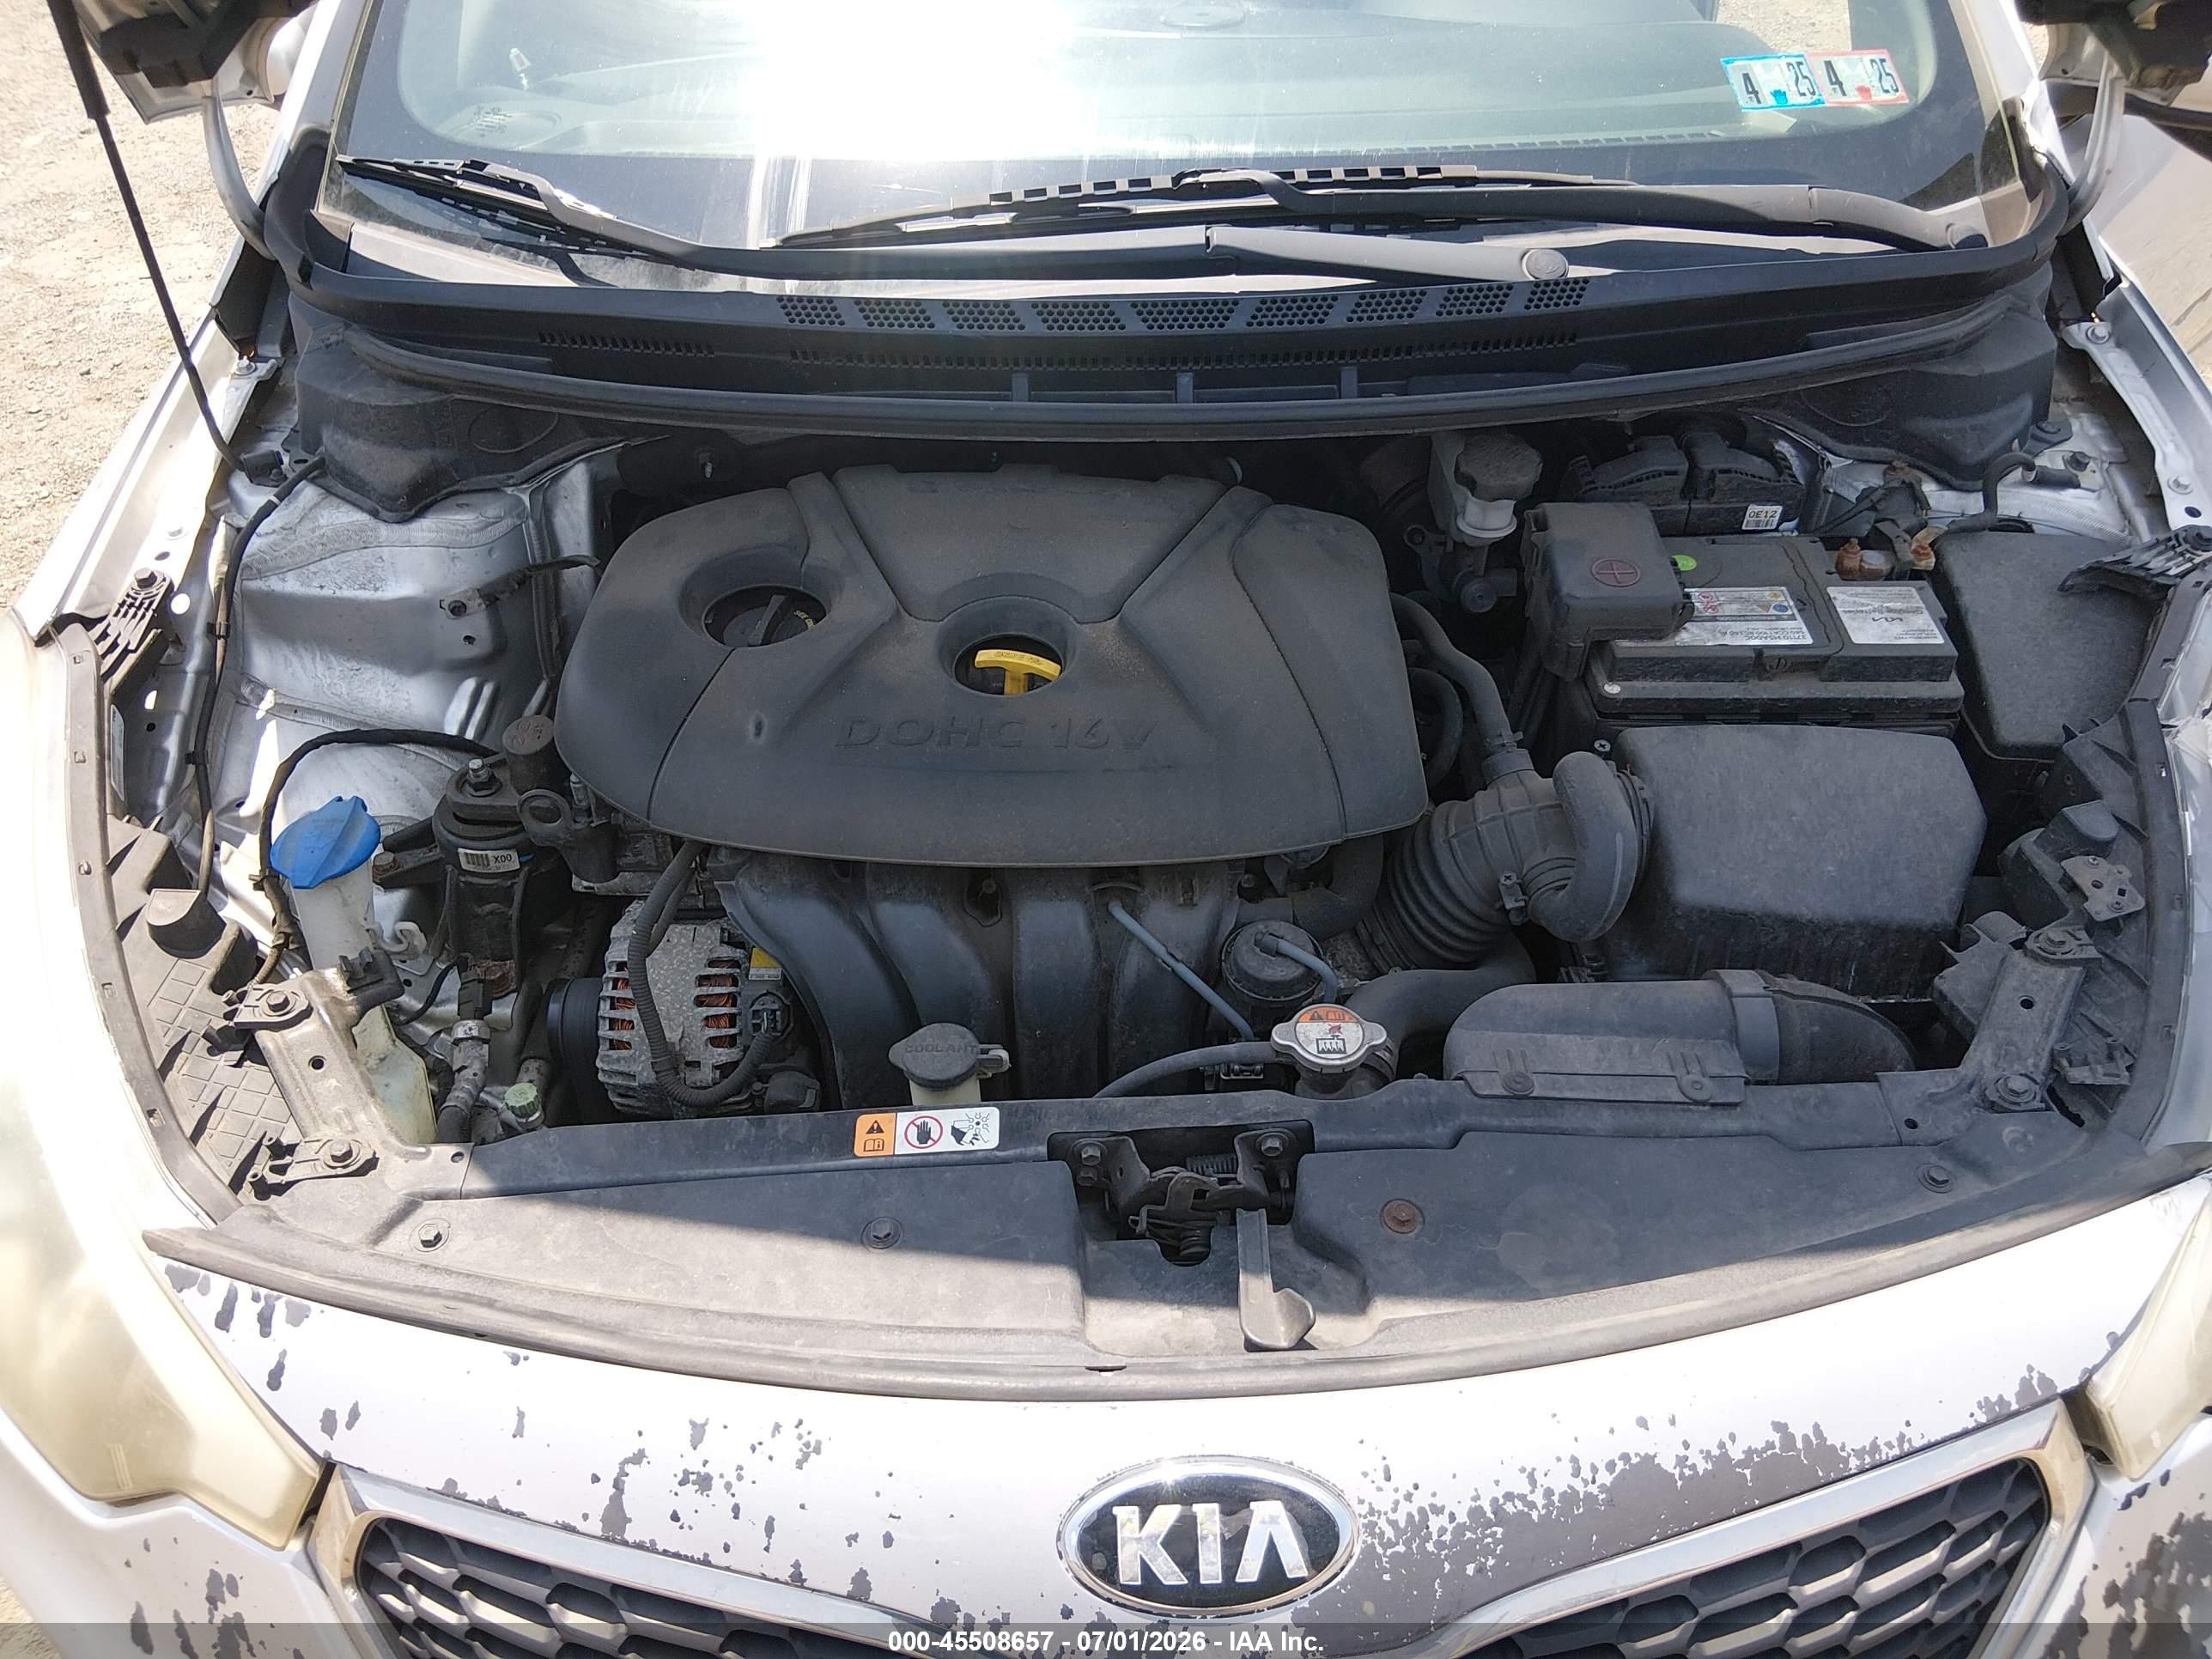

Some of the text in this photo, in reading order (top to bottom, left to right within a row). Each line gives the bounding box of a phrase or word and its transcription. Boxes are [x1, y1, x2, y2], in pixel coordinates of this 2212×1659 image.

[1742, 61, 1816, 104] 4 25
[1824, 58, 1899, 96] 4 25
[836, 716, 1160, 750] DOHC 16V
[494, 854, 513, 865] X00
[904, 1043, 978, 1054] COOLANT
[1113, 1500, 1309, 1586] KIA
